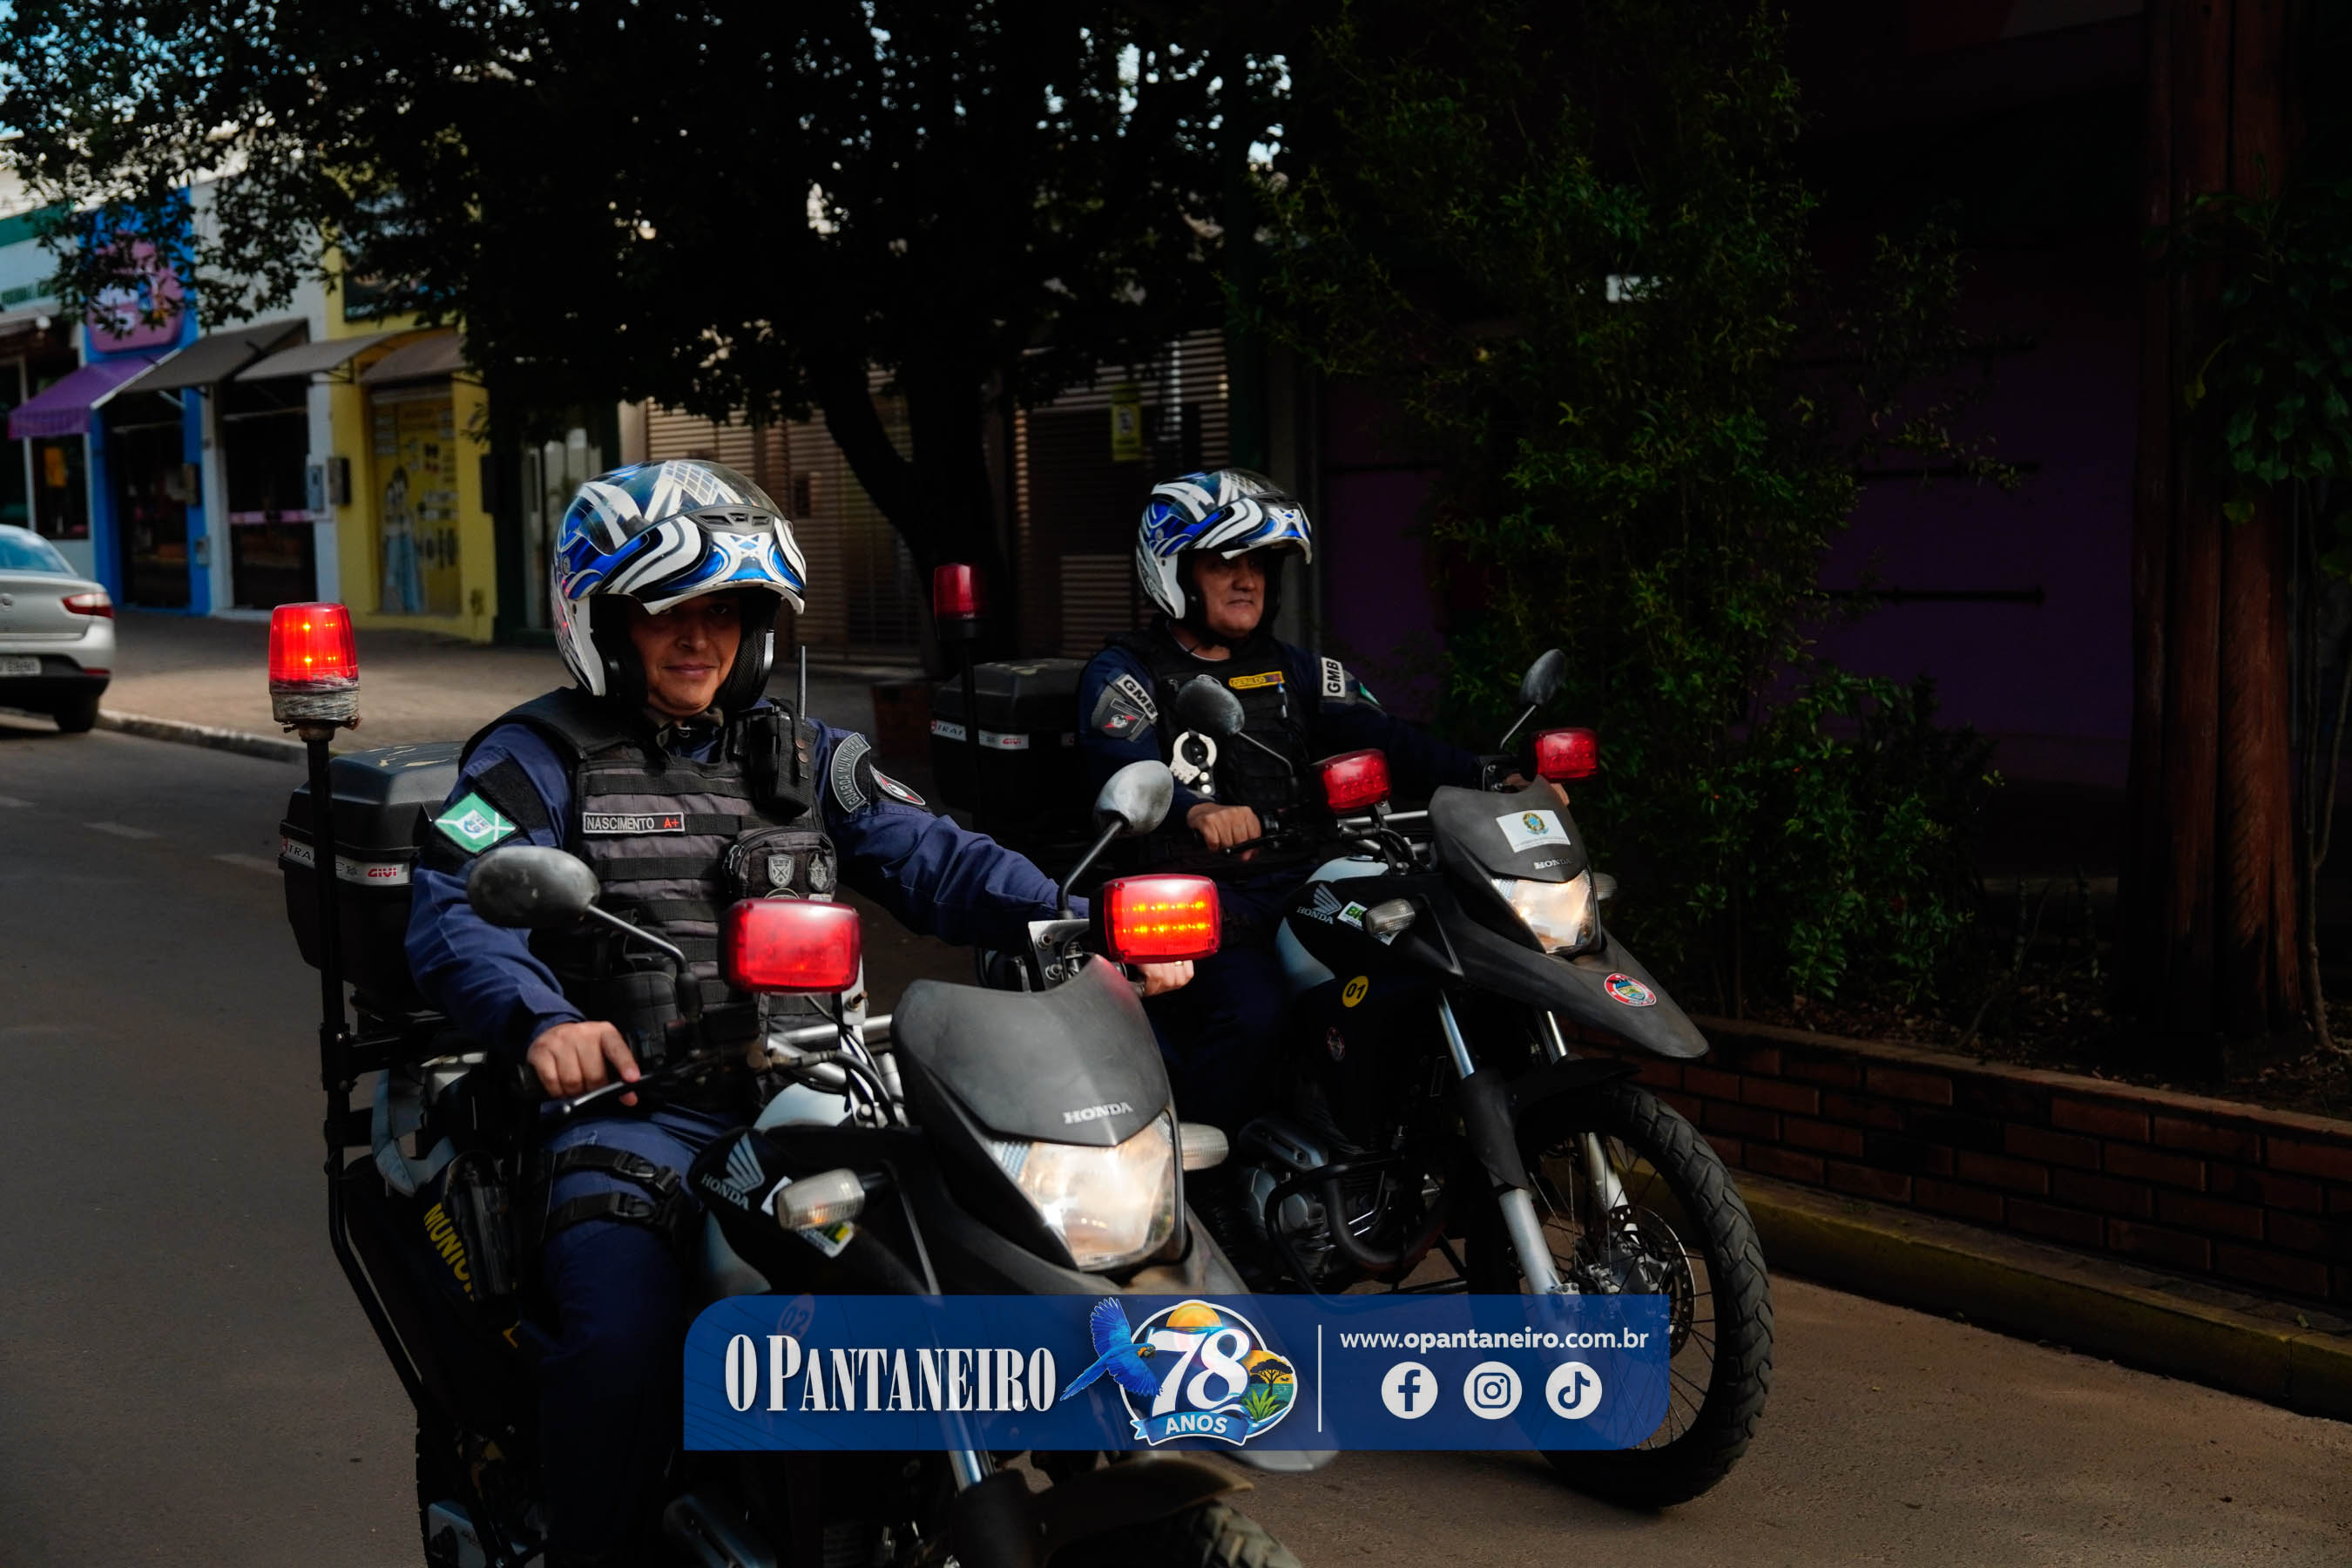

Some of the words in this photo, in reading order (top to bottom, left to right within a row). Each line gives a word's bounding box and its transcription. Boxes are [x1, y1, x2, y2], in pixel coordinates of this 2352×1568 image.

[1327, 660, 1341, 693] GMB
[1123, 679, 1157, 714] GMB
[837, 739, 864, 773] MUNICIPAL
[837, 774, 860, 805] GUARDA
[586, 816, 655, 830] NASCIMENTO
[663, 816, 680, 829] A+
[368, 868, 397, 878] GIVI
[1533, 858, 1573, 869] HONDA
[1296, 906, 1335, 925] HONDA
[1346, 983, 1366, 999] 01
[1063, 1102, 1134, 1125] HONDA
[700, 1173, 751, 1212] HONDA
[422, 1200, 475, 1303] MUNIC
